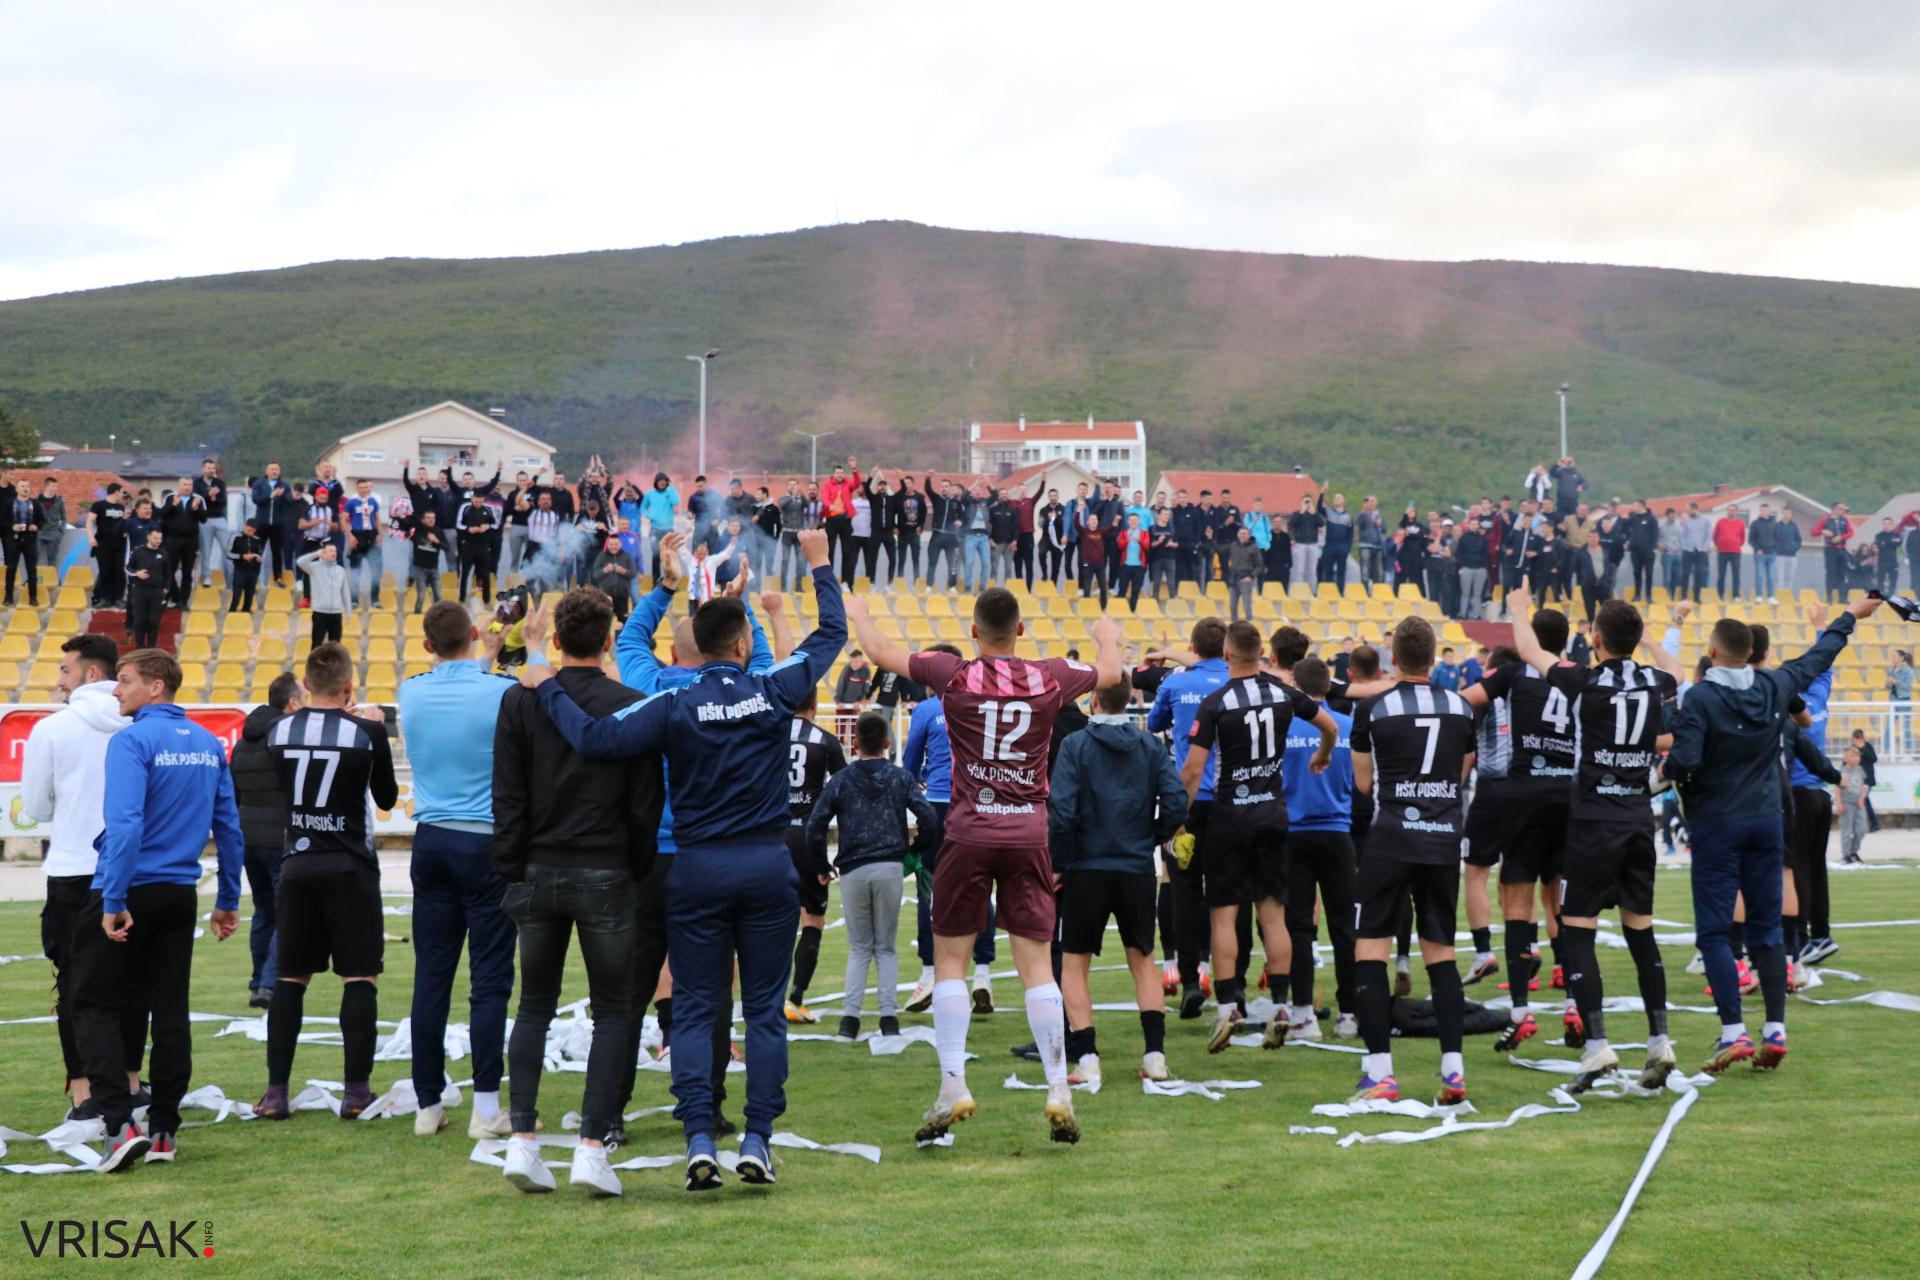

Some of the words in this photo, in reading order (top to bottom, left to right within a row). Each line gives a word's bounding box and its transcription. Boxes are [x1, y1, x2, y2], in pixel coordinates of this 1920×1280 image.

[697, 701, 725, 721] HŠK
[725, 692, 774, 720] POSUŠ
[1541, 686, 1570, 734] 4
[1610, 690, 1649, 745] 17
[978, 700, 1032, 761] 12
[1243, 707, 1276, 760] 11
[1286, 735, 1307, 748] HŠK
[1414, 718, 1440, 775] 7
[155, 749, 178, 766] HŠK
[283, 749, 341, 808] 77
[788, 744, 807, 788] 3
[976, 803, 1035, 815] weltplast
[1395, 780, 1417, 798] HŠK
[1417, 780, 1458, 799] POSUŠJE
